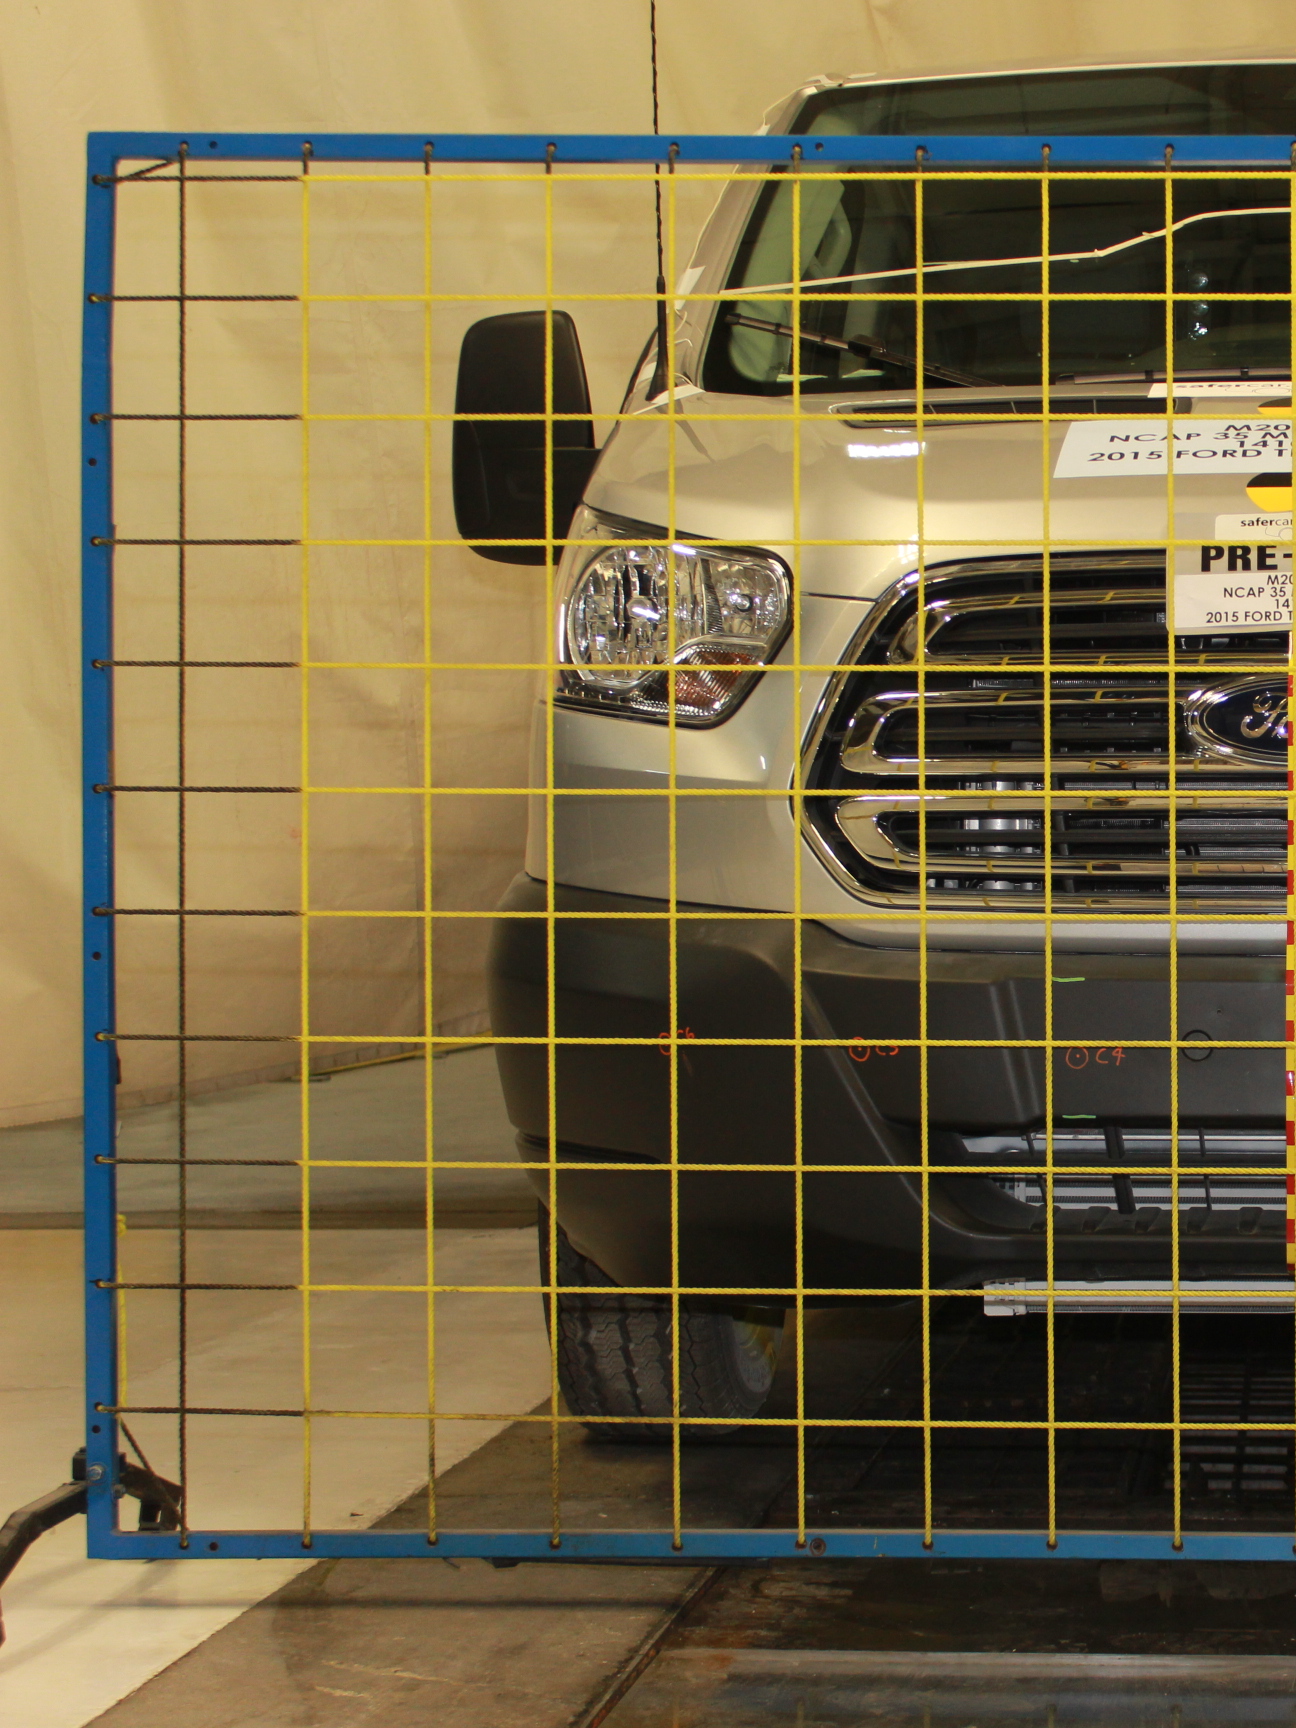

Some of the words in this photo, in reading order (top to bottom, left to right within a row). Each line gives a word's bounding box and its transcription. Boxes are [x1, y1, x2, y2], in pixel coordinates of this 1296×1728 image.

[1109, 432, 1202, 443] NCAP
[1213, 432, 1249, 440] 35
[1087, 450, 1164, 462] 2015
[1175, 448, 1262, 459] FORD
[1223, 587, 1265, 599] NCAP
[1270, 586, 1286, 598] 35
[1206, 611, 1239, 624] 2015
[1244, 611, 1283, 622] FORD
